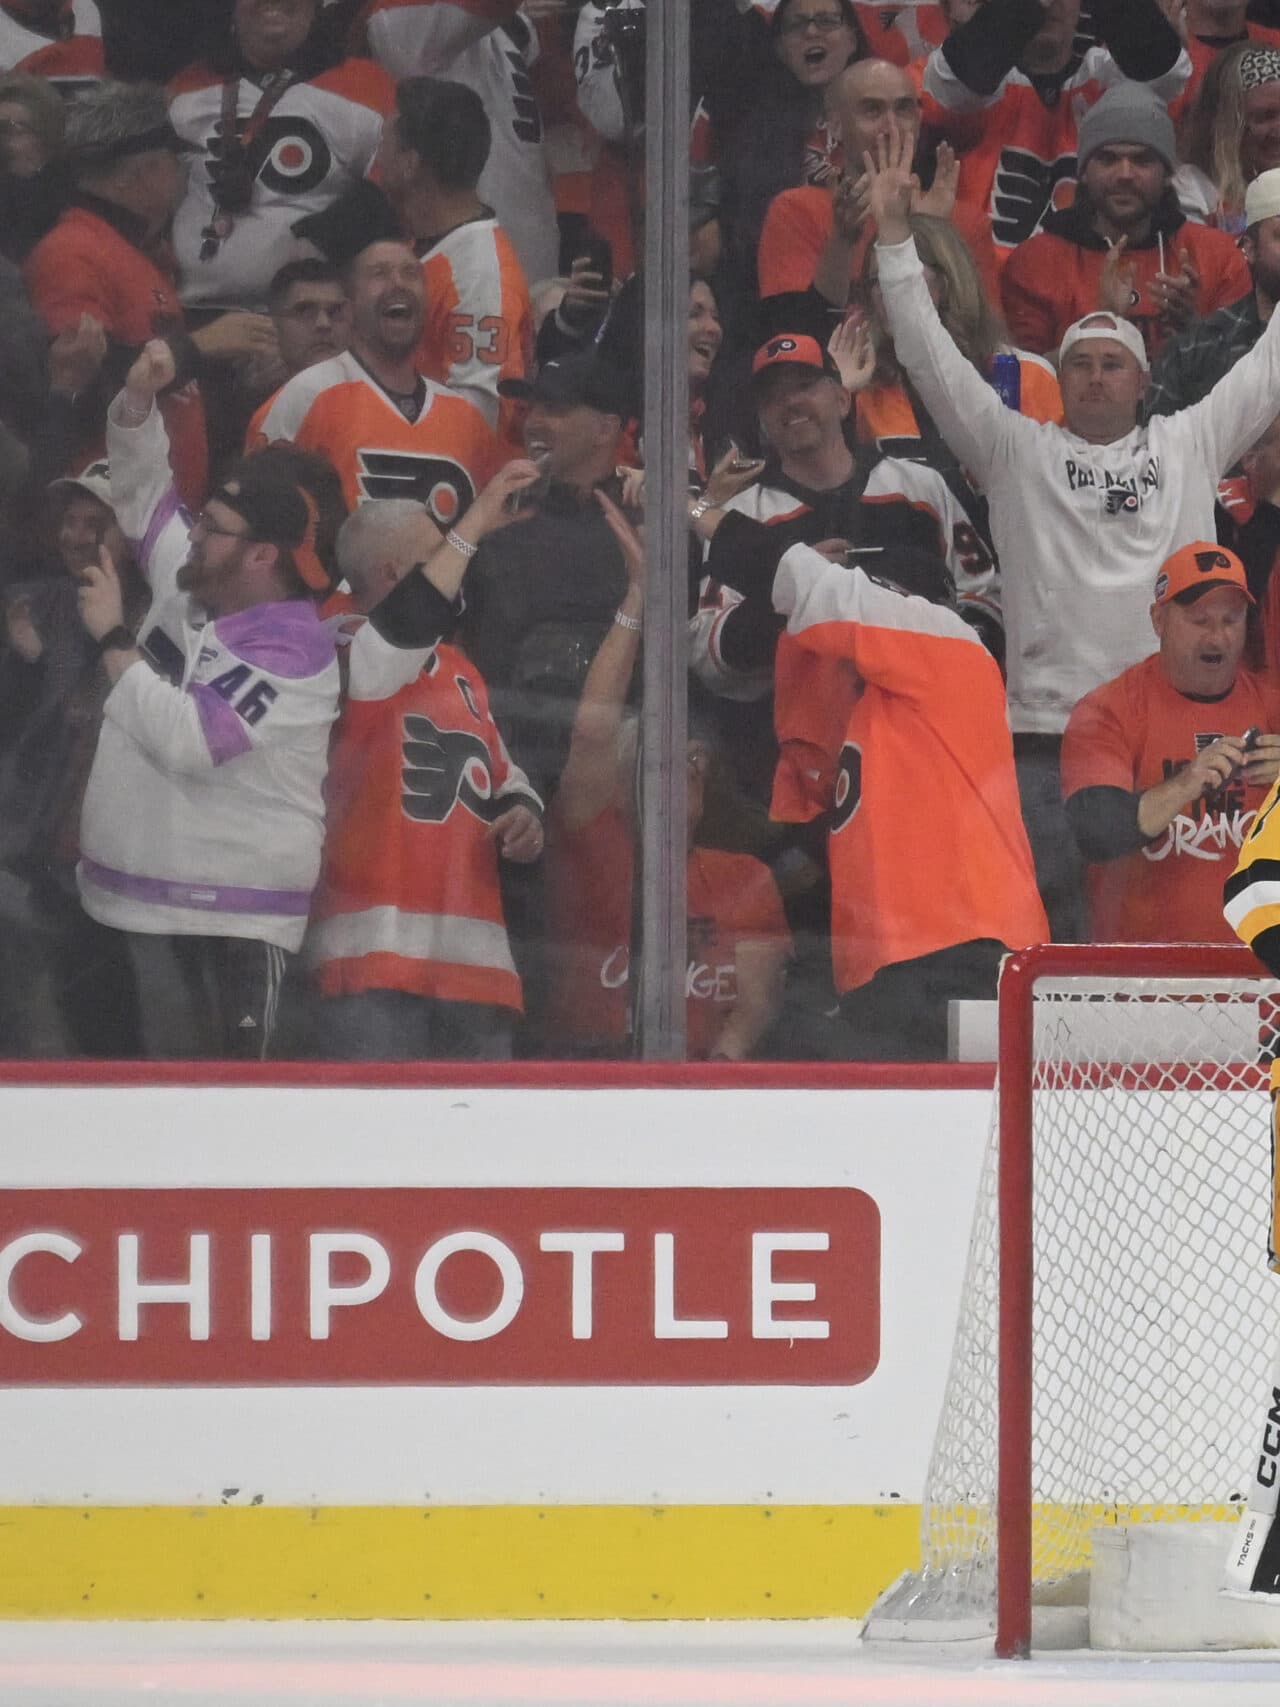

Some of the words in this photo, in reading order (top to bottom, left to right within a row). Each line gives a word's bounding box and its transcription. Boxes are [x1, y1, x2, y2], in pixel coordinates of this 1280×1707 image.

[207, 663, 279, 727] 46
[0, 1231, 830, 1342] CHIPOTLE
[1237, 1532, 1254, 1567] TACKS
